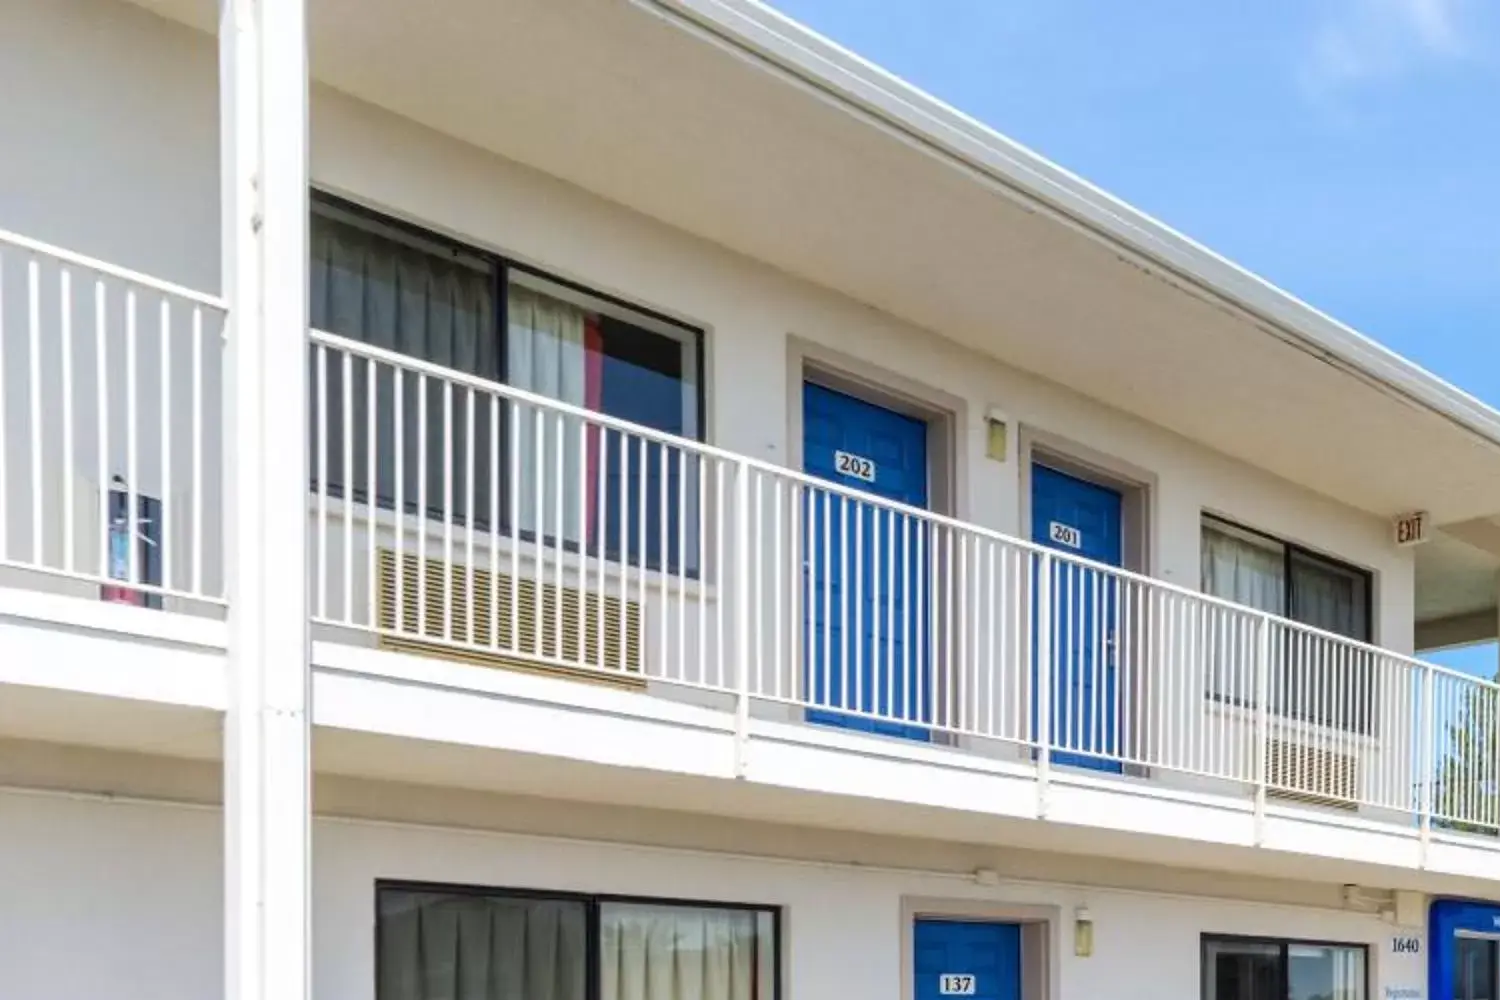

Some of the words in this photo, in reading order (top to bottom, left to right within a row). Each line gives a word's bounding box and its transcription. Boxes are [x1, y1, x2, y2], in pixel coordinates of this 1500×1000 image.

[839, 455, 871, 477] 202
[1054, 525, 1077, 545] 201
[1398, 517, 1421, 543] EXIT
[1392, 937, 1420, 953] 1640
[945, 977, 971, 992] 137
